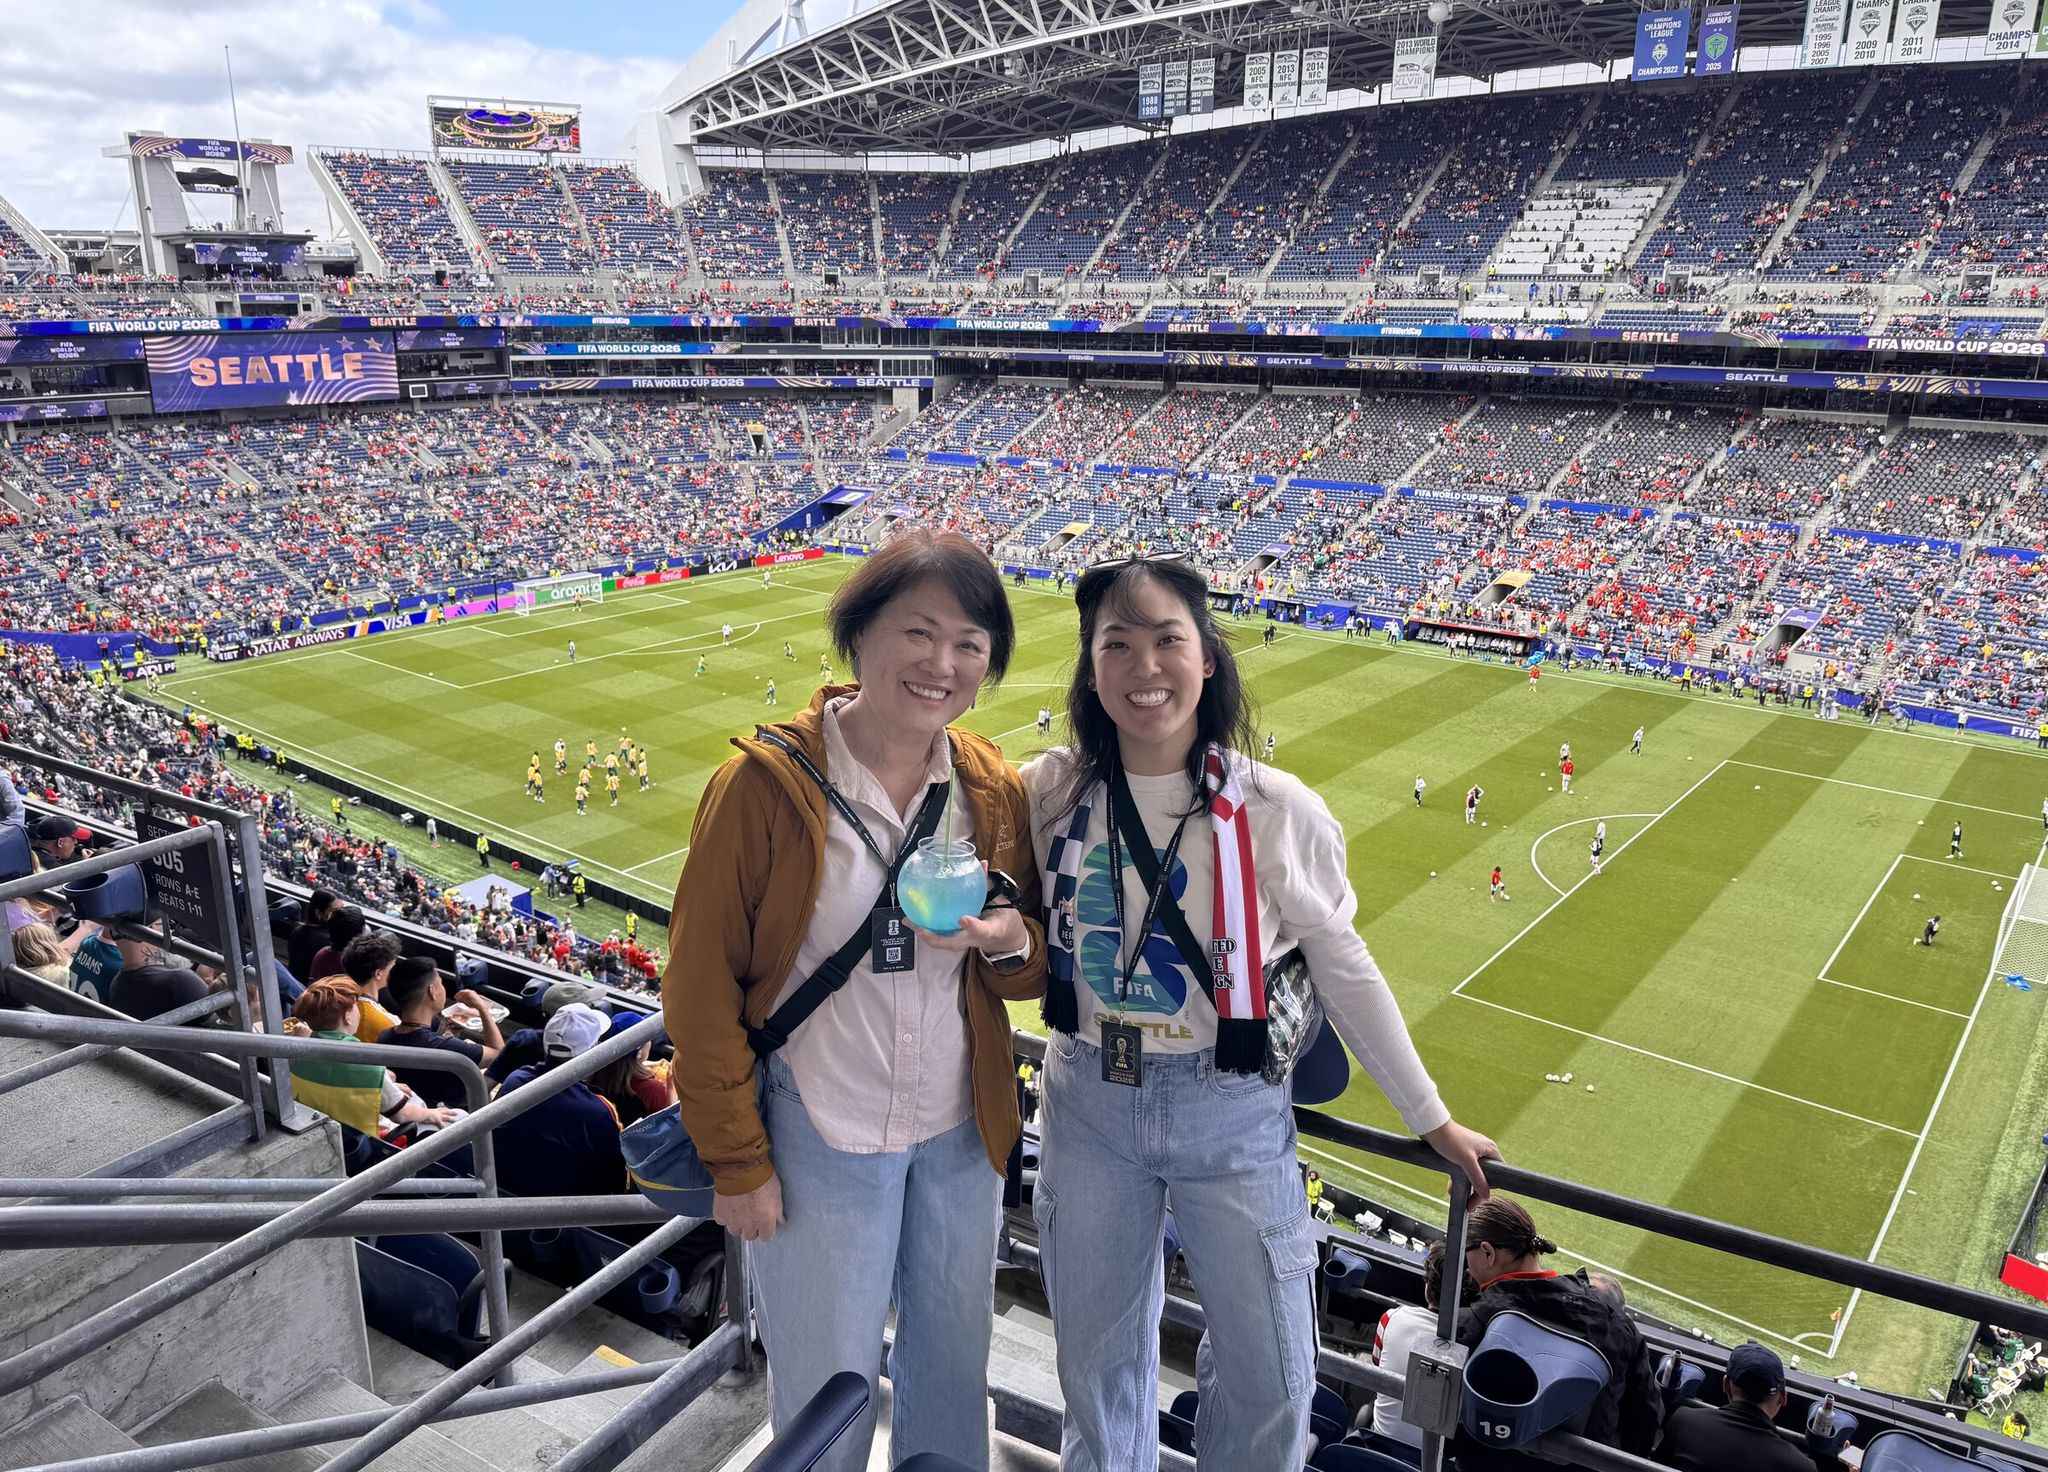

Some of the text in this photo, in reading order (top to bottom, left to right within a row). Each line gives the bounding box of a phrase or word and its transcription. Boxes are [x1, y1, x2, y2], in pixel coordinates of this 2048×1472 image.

[1856, 0, 1890, 10] CHAMPS
[1644, 20, 1682, 31] CHAMPIONS
[1706, 16, 1732, 25] CHAMPS
[1650, 29, 1674, 38] LEAGUE
[1988, 30, 2031, 41] CHAMPS
[1414, 38, 1435, 47] WORLD
[1856, 40, 1878, 50] 2009
[1902, 36, 1924, 46] 2011
[1996, 40, 2020, 50] 2014
[1396, 46, 1435, 56] CHAMPIONS
[1854, 50, 1876, 60] 2010
[1901, 47, 1922, 56] 2014
[1278, 64, 1295, 73] 2013
[1306, 62, 1324, 71] 2014
[1638, 66, 1662, 76] CHAMPS
[1706, 62, 1722, 70] 2025
[1249, 67, 1266, 76] 2005
[1142, 106, 1158, 115] 1999
[89, 319, 221, 332] FIFA WORLD CUP 2026
[370, 317, 417, 326] SEATTLE
[794, 318, 836, 326] SEATTLE
[956, 320, 1049, 330] FIFA WORLD CUP 2026
[1168, 324, 1210, 333] SEATTLE
[1622, 332, 1679, 342] SEATTLE
[578, 344, 681, 353] FIFA WORLD CUP 2026
[1868, 338, 2046, 354] FIFA WORLD CUP 2026
[189, 352, 363, 387] SEATTLE
[856, 378, 920, 387] SEATTLE
[1726, 373, 1788, 382] SEATTLE
[632, 379, 745, 388] FIFA WORLD CUP 2026
[1414, 489, 1432, 498] FIFA
[1432, 491, 1460, 500] WORLD
[774, 552, 805, 563] Lenovo
[660, 570, 683, 582] Coca-Cola
[623, 576, 646, 588] Coca-Cola
[550, 582, 602, 600] aramco
[384, 616, 412, 630] VISA
[248, 637, 290, 657] QATAR
[294, 628, 345, 647] AIRWAYS
[136, 664, 162, 677] ADI
[2011, 726, 2040, 740] FIFA
[156, 874, 200, 899] ROWS A-E
[158, 892, 202, 917] SEATS 1-11
[76, 951, 103, 975] ADAMS
[1114, 977, 1157, 1001] FIFA
[1480, 1421, 1511, 1438] 19
